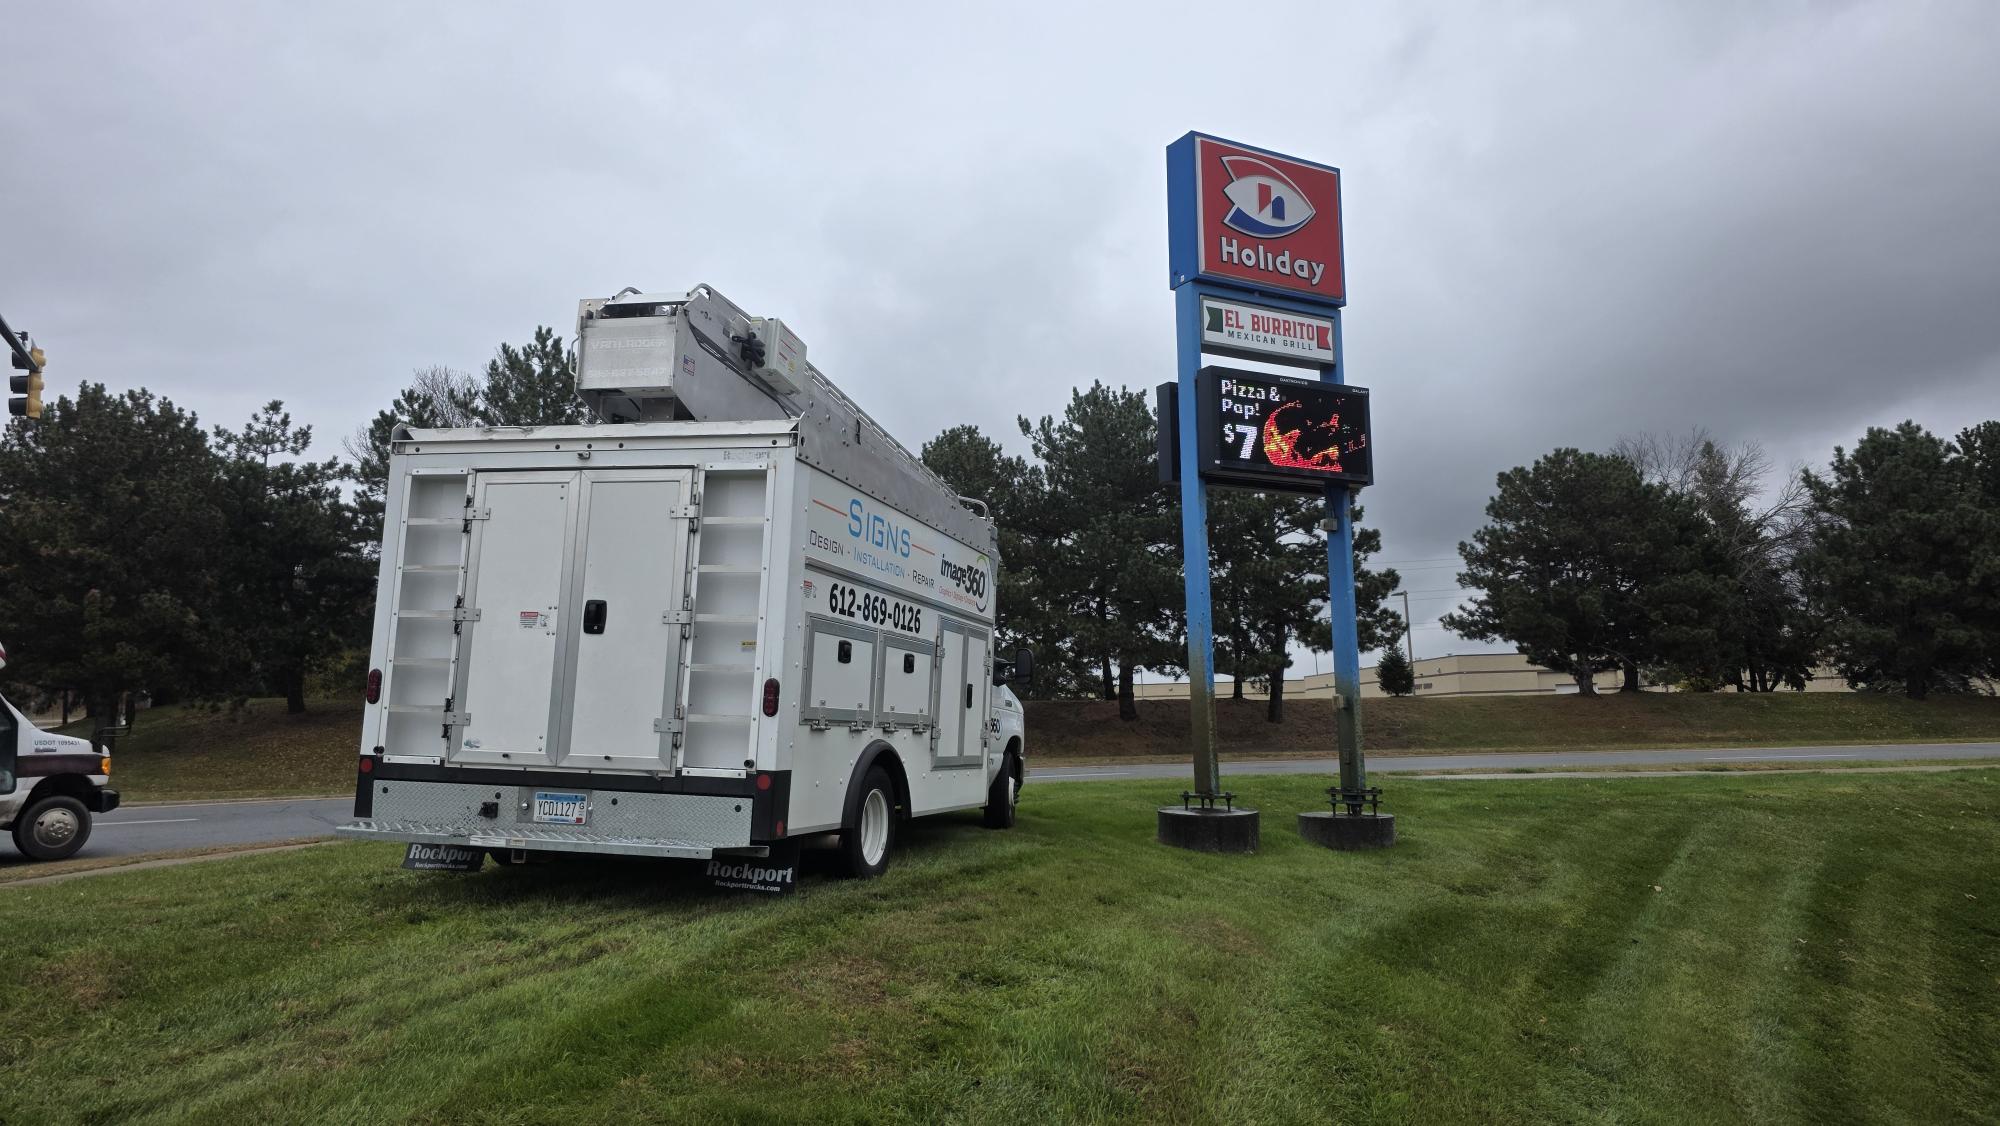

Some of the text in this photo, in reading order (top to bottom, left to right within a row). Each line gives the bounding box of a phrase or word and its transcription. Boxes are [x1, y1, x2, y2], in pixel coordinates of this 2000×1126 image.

[1220, 236, 1325, 286] Holiday
[1224, 309, 1315, 341] EL BURRITO
[1227, 330, 1313, 351] MEXICAN GRILL
[1221, 379, 1280, 402] Pizza &
[1222, 398, 1261, 420] Pop!
[940, 553, 986, 599] image360
[829, 582, 921, 634] 612-869-0126
[538, 800, 577, 817] YCD1127
[706, 860, 793, 883] Rockport
[715, 880, 781, 892] Rockporttrucks.com
